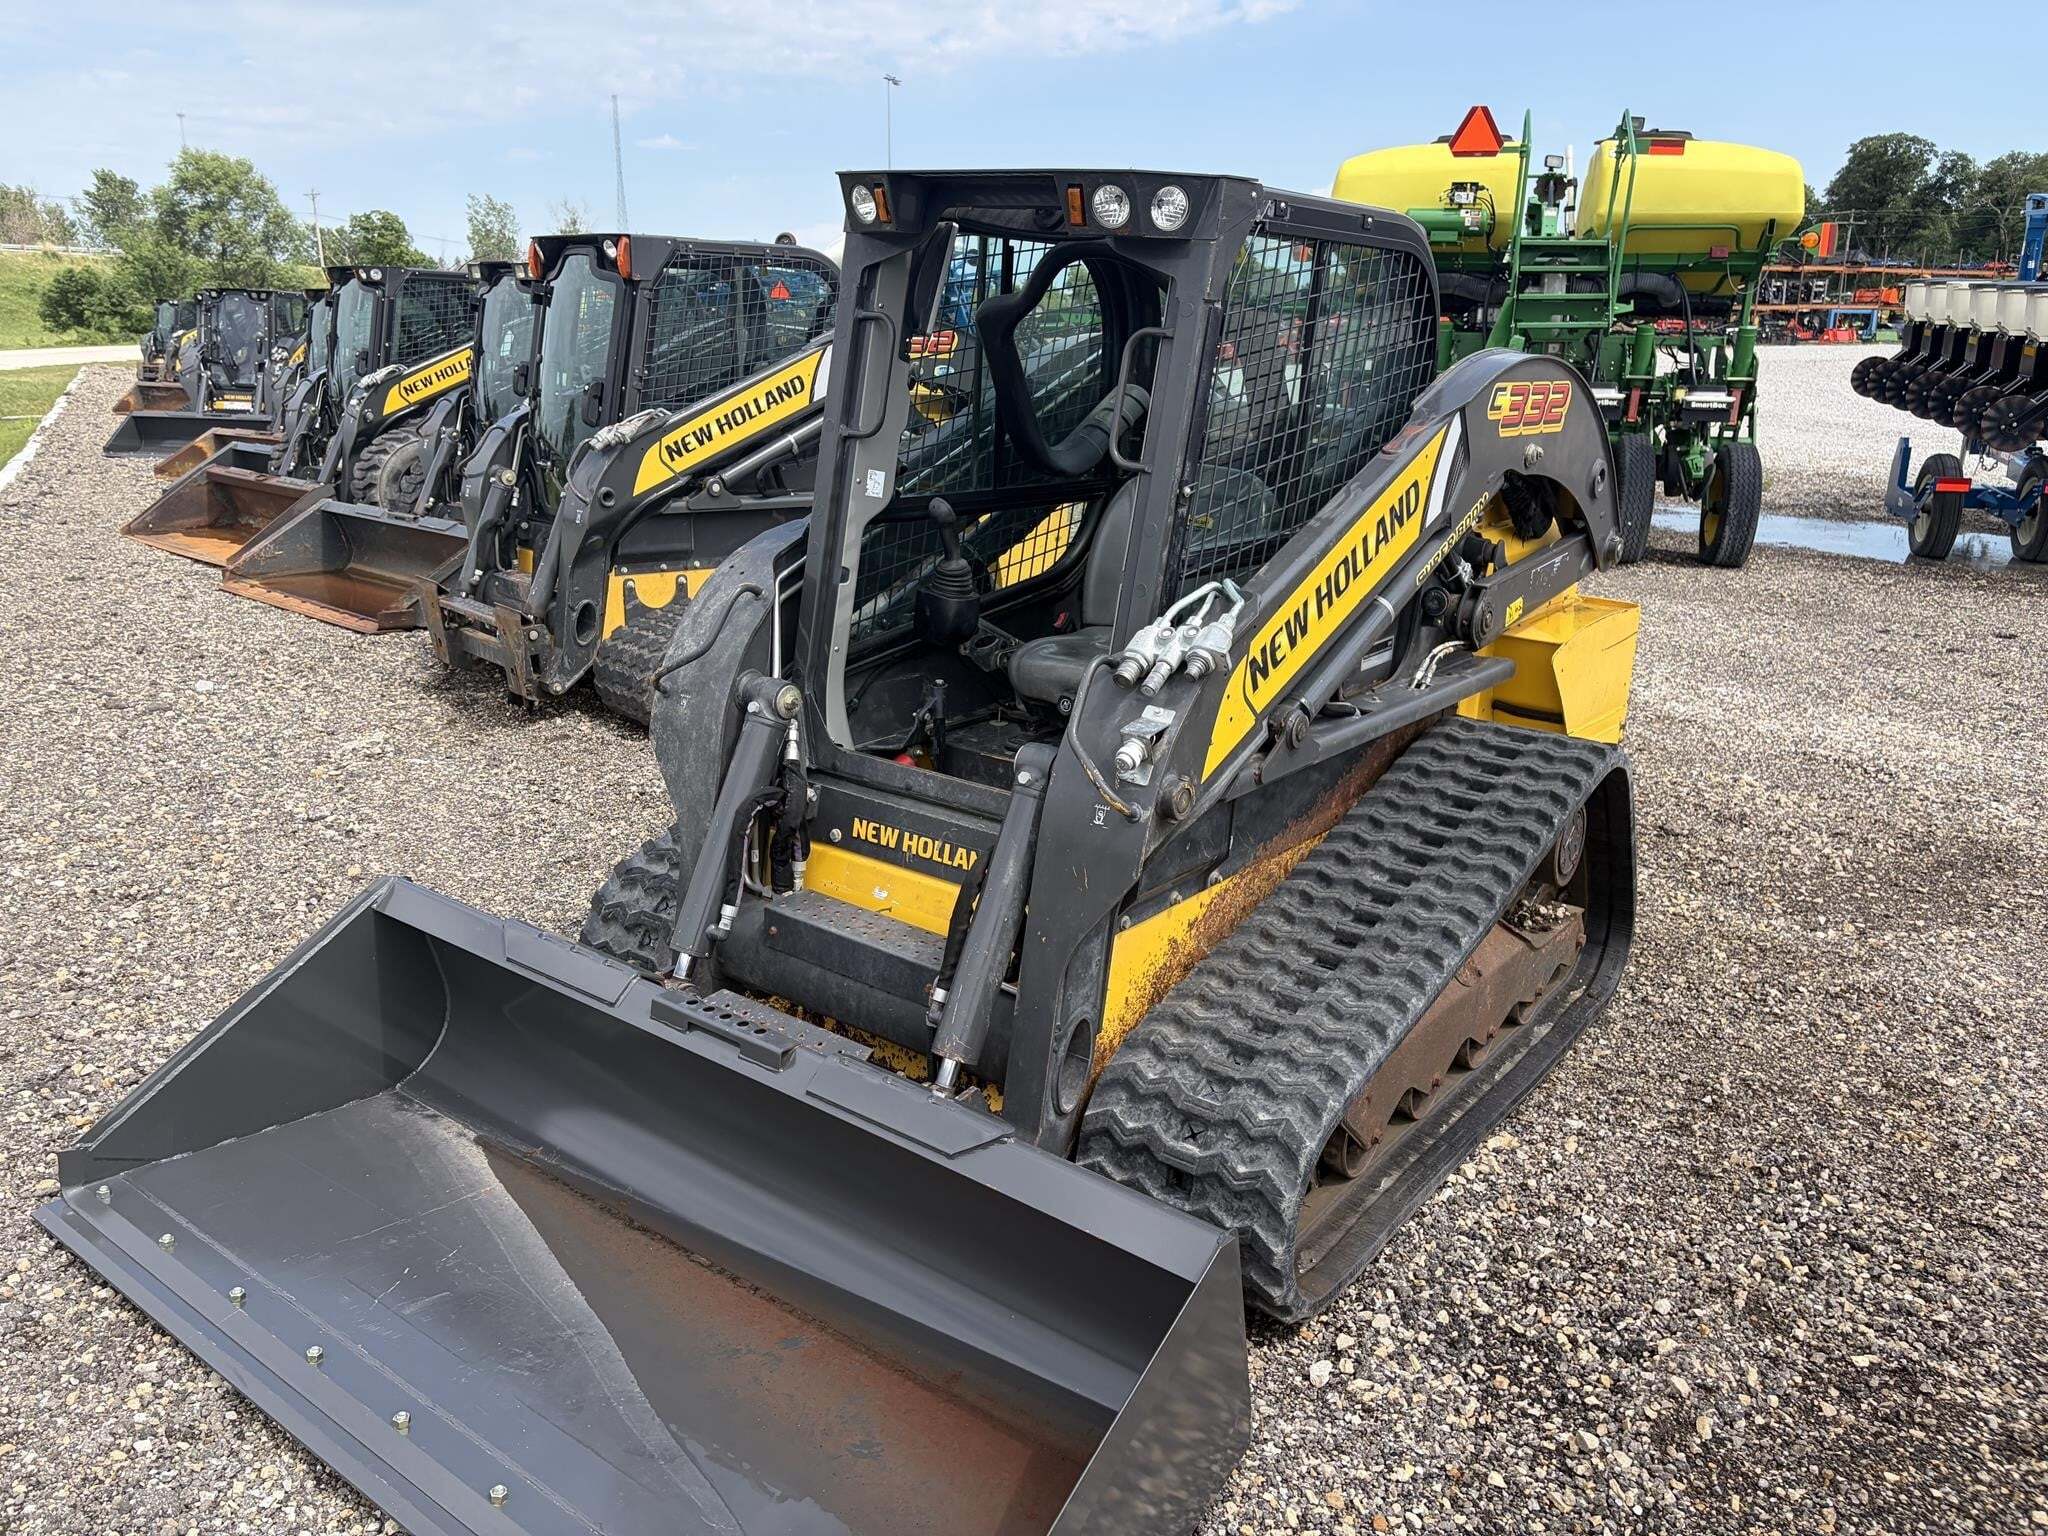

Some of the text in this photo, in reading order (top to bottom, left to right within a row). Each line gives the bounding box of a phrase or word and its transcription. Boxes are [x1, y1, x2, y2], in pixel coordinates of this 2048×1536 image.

[403, 374, 434, 396] NEW
[664, 374, 806, 462] NEW HOLLAND
[1691, 401, 1727, 409] SmartBox
[1248, 598, 1309, 694] NEW
[1315, 479, 1421, 623] HOLLAND
[852, 817, 900, 849] NEW
